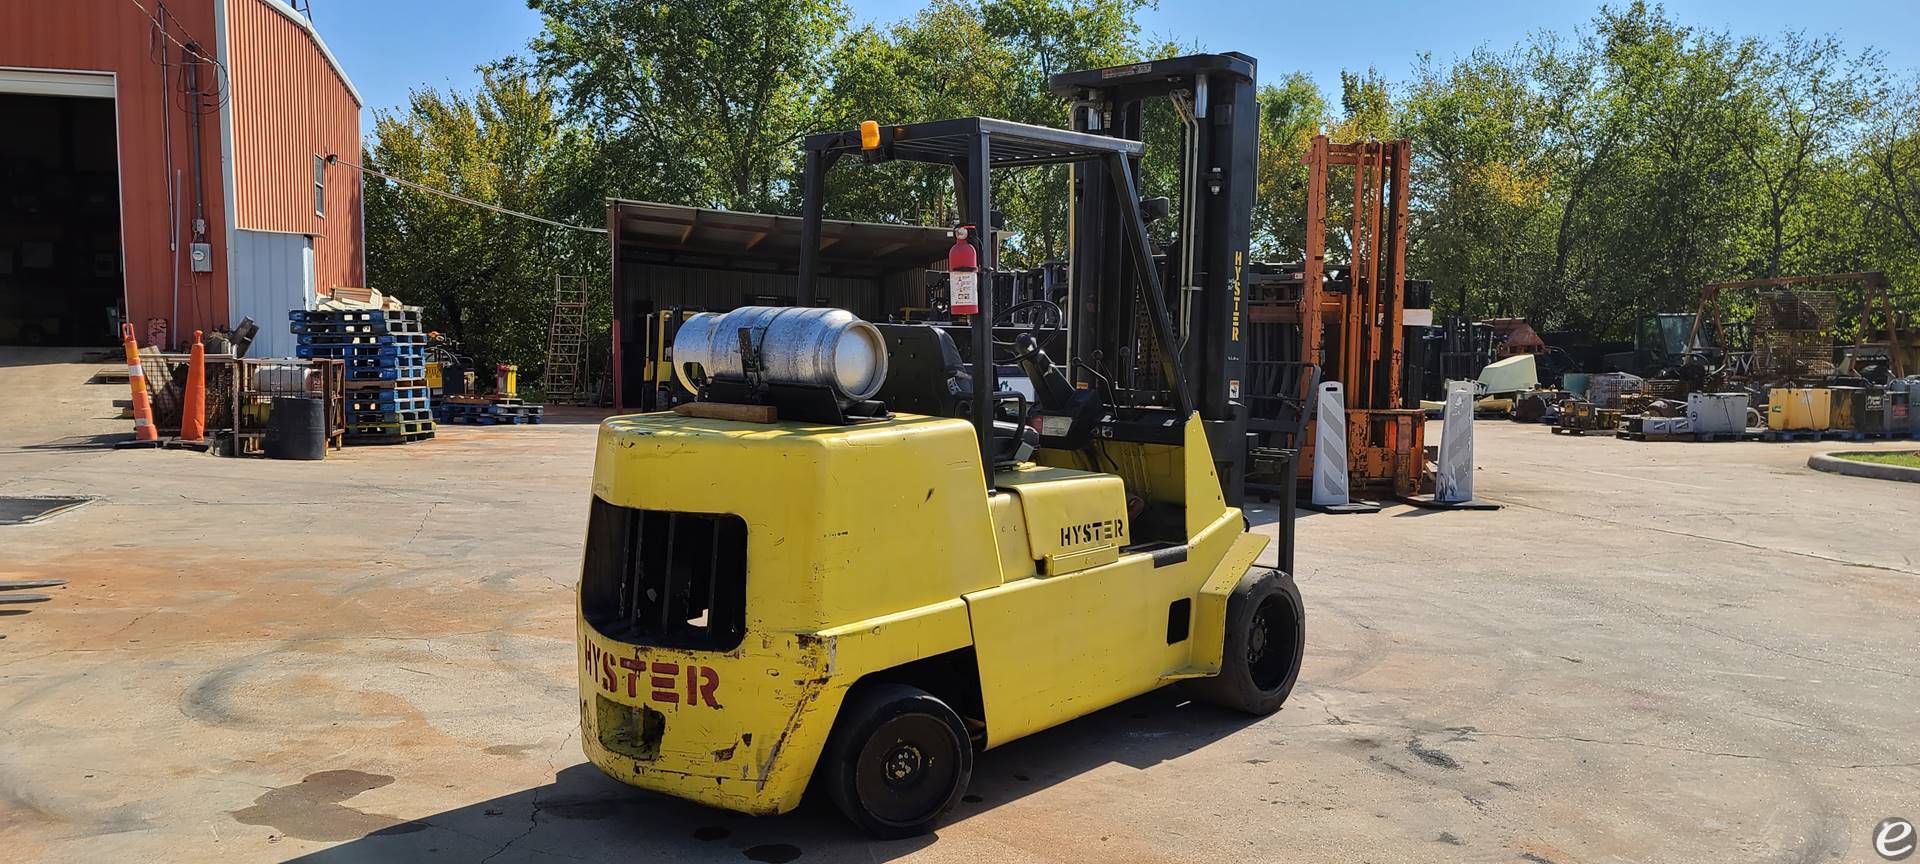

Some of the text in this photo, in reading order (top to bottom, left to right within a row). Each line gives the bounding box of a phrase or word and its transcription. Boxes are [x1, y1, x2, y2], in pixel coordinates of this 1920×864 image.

[1232, 251, 1242, 341] HYSTER
[1061, 519, 1123, 546] HYSTER
[584, 634, 721, 710] HYSTER
